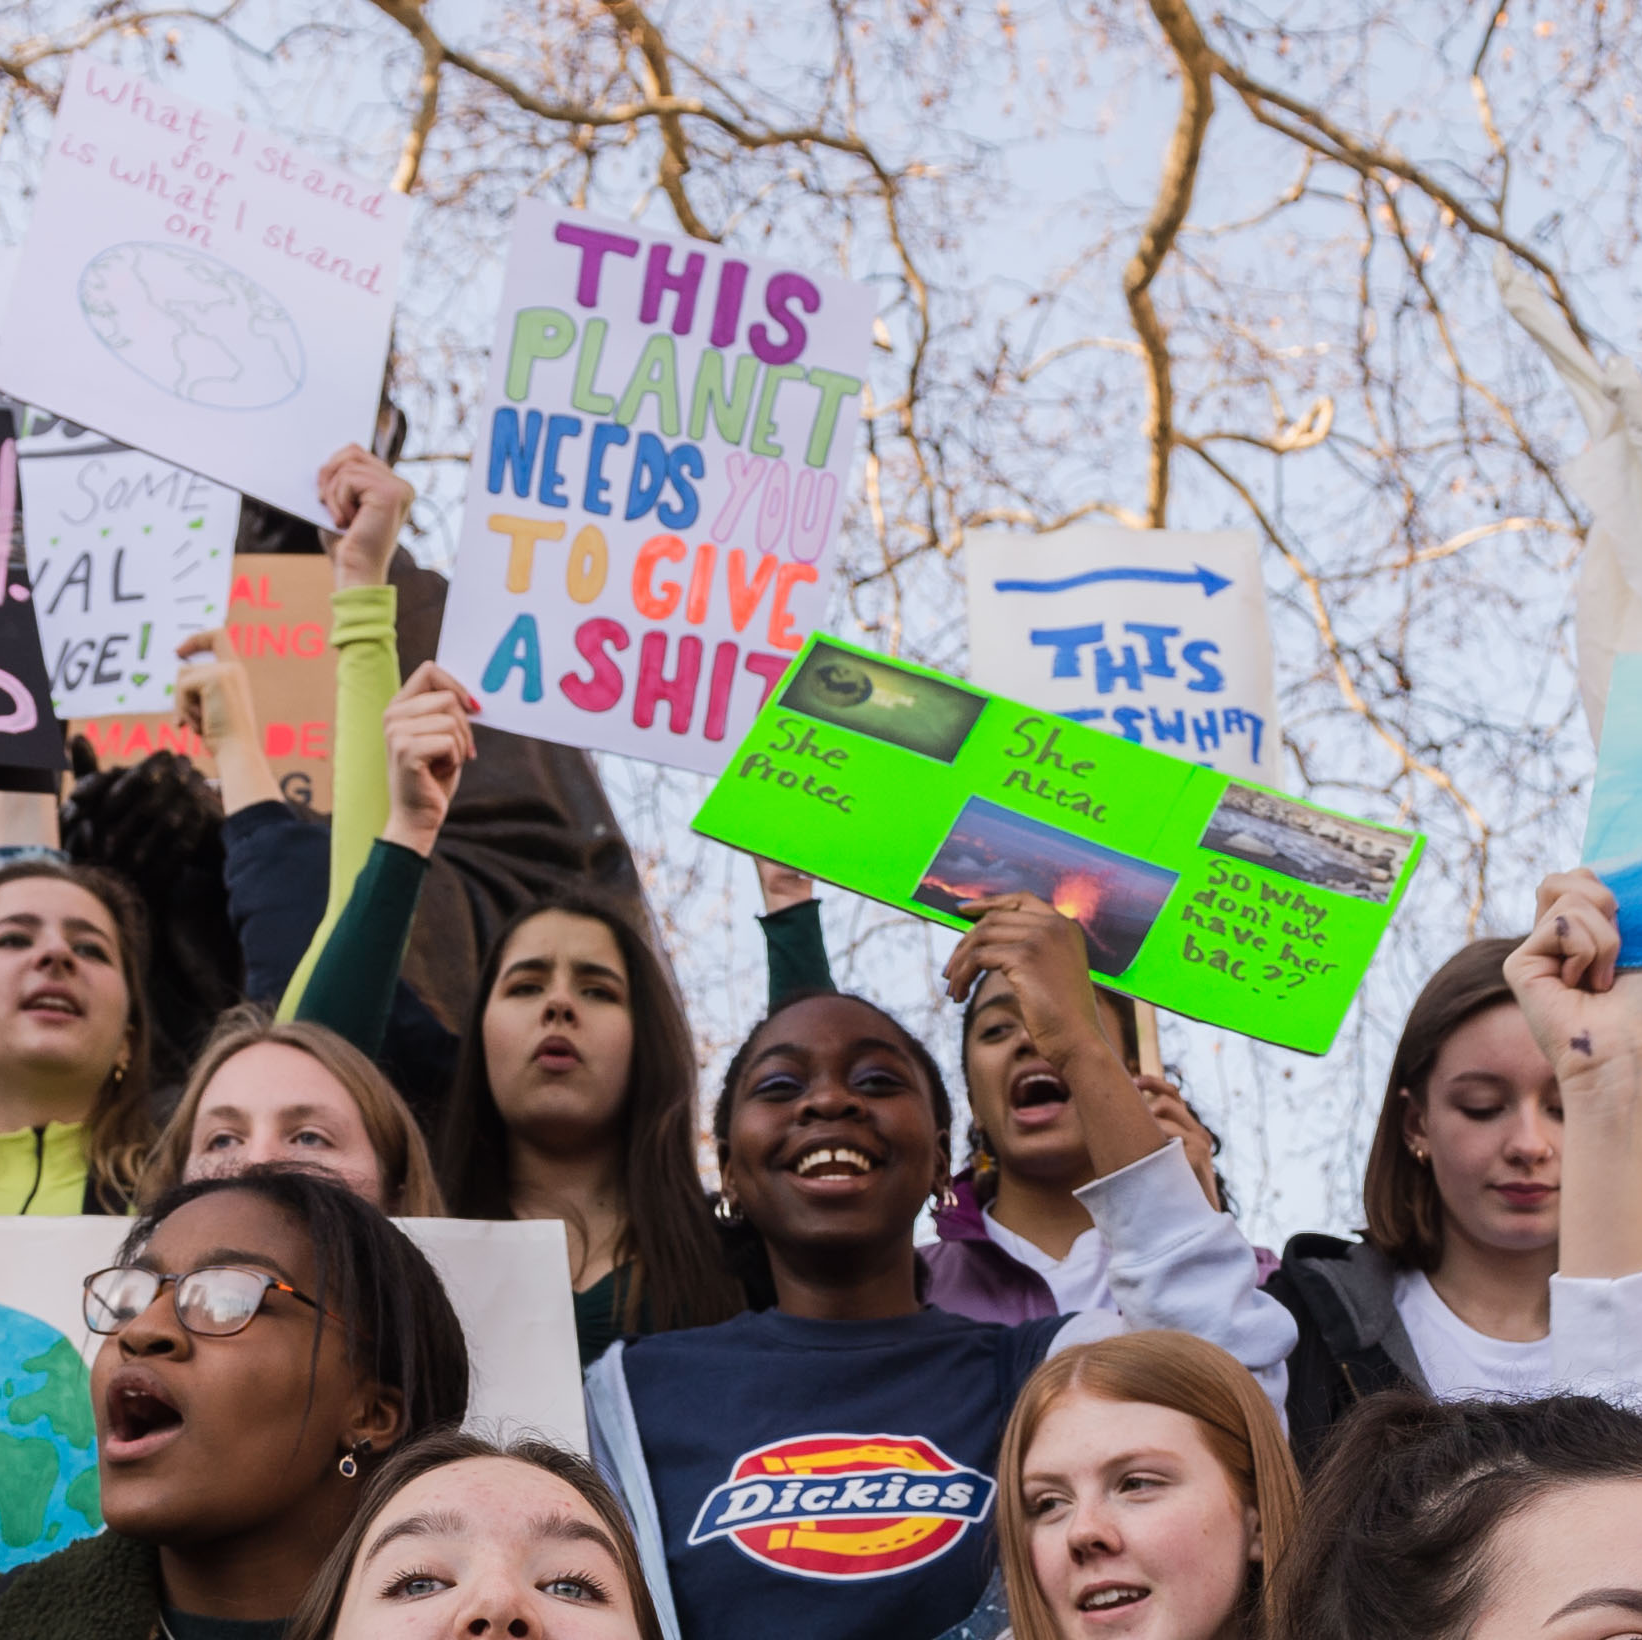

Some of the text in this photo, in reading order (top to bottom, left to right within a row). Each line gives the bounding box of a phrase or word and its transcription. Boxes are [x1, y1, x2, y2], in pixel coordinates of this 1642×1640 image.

[84, 65, 213, 144] What
[255, 144, 385, 219] stand
[170, 143, 235, 188] for
[60, 131, 98, 166] is
[108, 154, 219, 222] what
[262, 222, 383, 296] stand
[164, 212, 212, 249] on
[553, 221, 822, 366] THIS
[504, 305, 862, 470] PLANET
[487, 406, 839, 566] NEEDS YOU
[487, 513, 820, 652] TO GIVE
[480, 610, 795, 743] A SHIT
[1029, 620, 1227, 694] THIS
[768, 716, 850, 770] She
[1003, 716, 1096, 779] She
[1147, 705, 1266, 766] WHAT
[1181, 903, 1340, 976] have her
[1182, 932, 1247, 983] bac
[714, 1475, 975, 1526] Dickies
